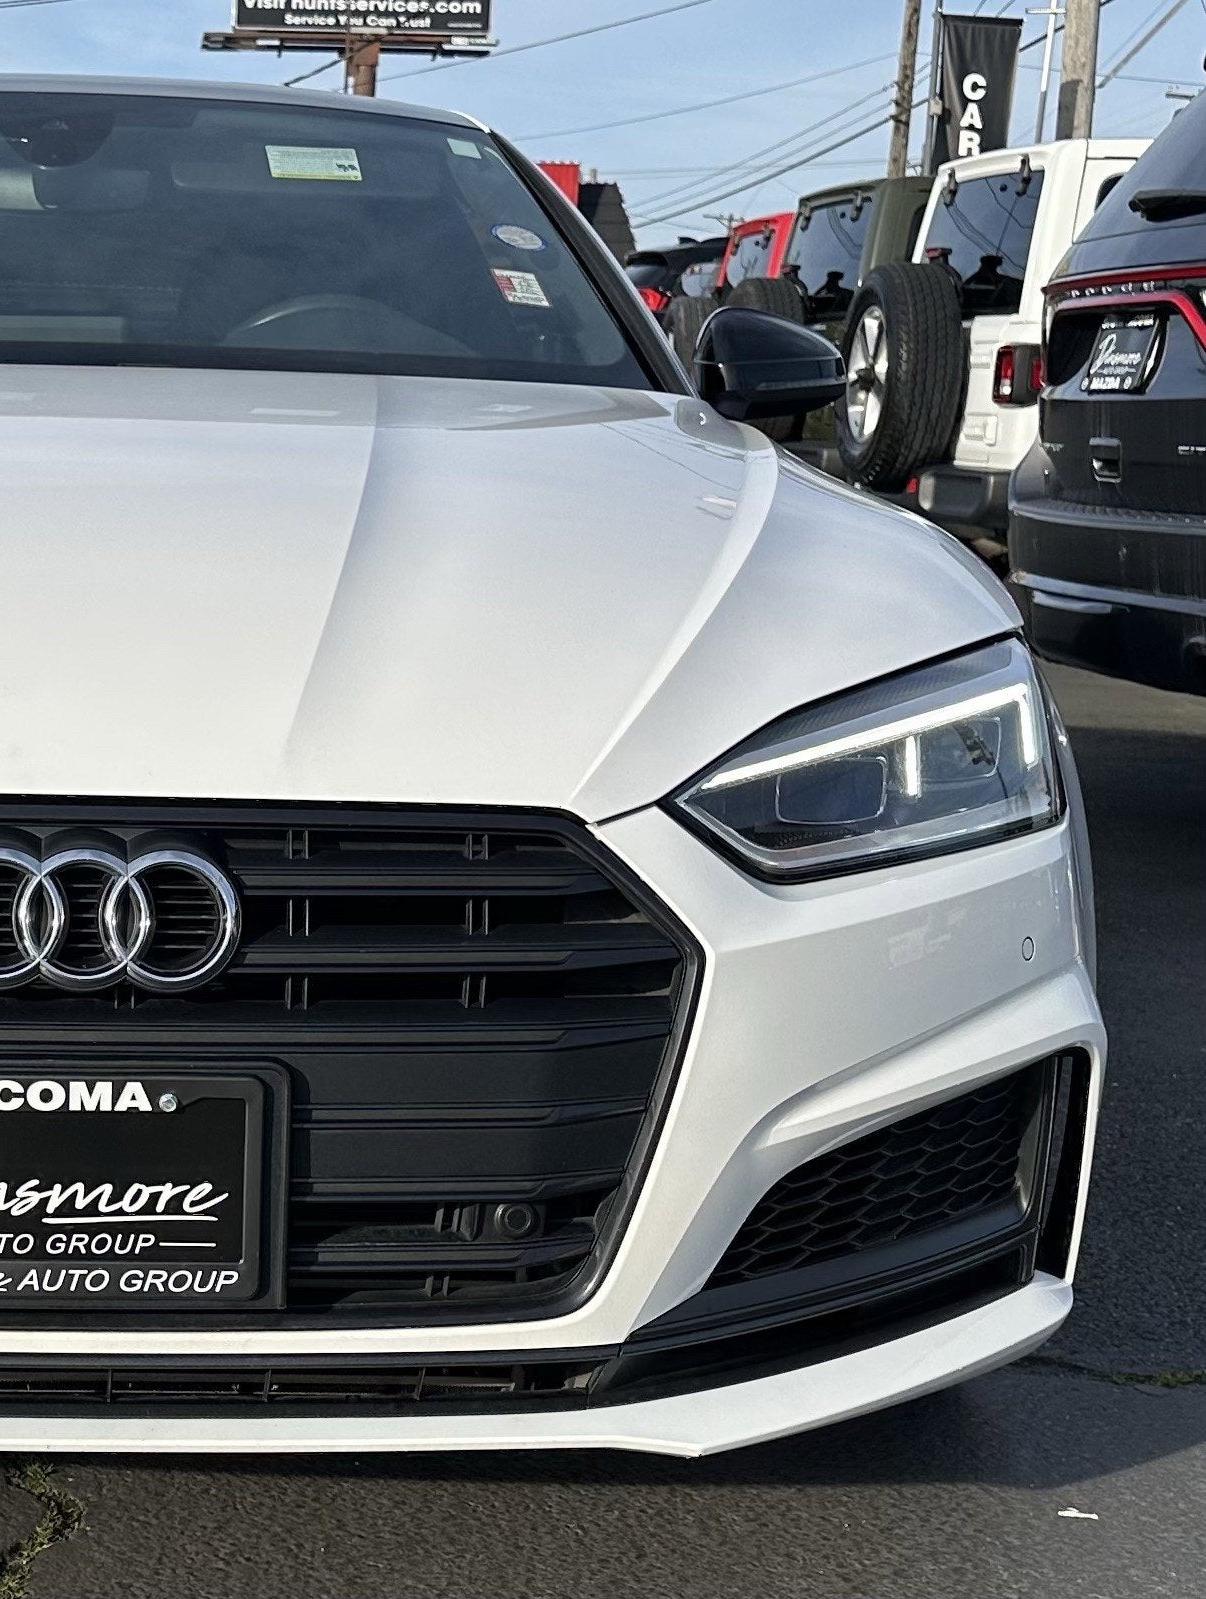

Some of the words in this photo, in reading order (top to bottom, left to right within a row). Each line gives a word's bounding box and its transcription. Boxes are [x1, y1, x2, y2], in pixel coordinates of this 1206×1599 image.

[284, 13, 336, 25] Service
[366, 15, 397, 27] Can
[957, 72, 987, 157] CAR
[45, 1233, 156, 1255] GROUP
[16, 1269, 110, 1292] AUTO
[119, 1269, 239, 1293] GROUP
